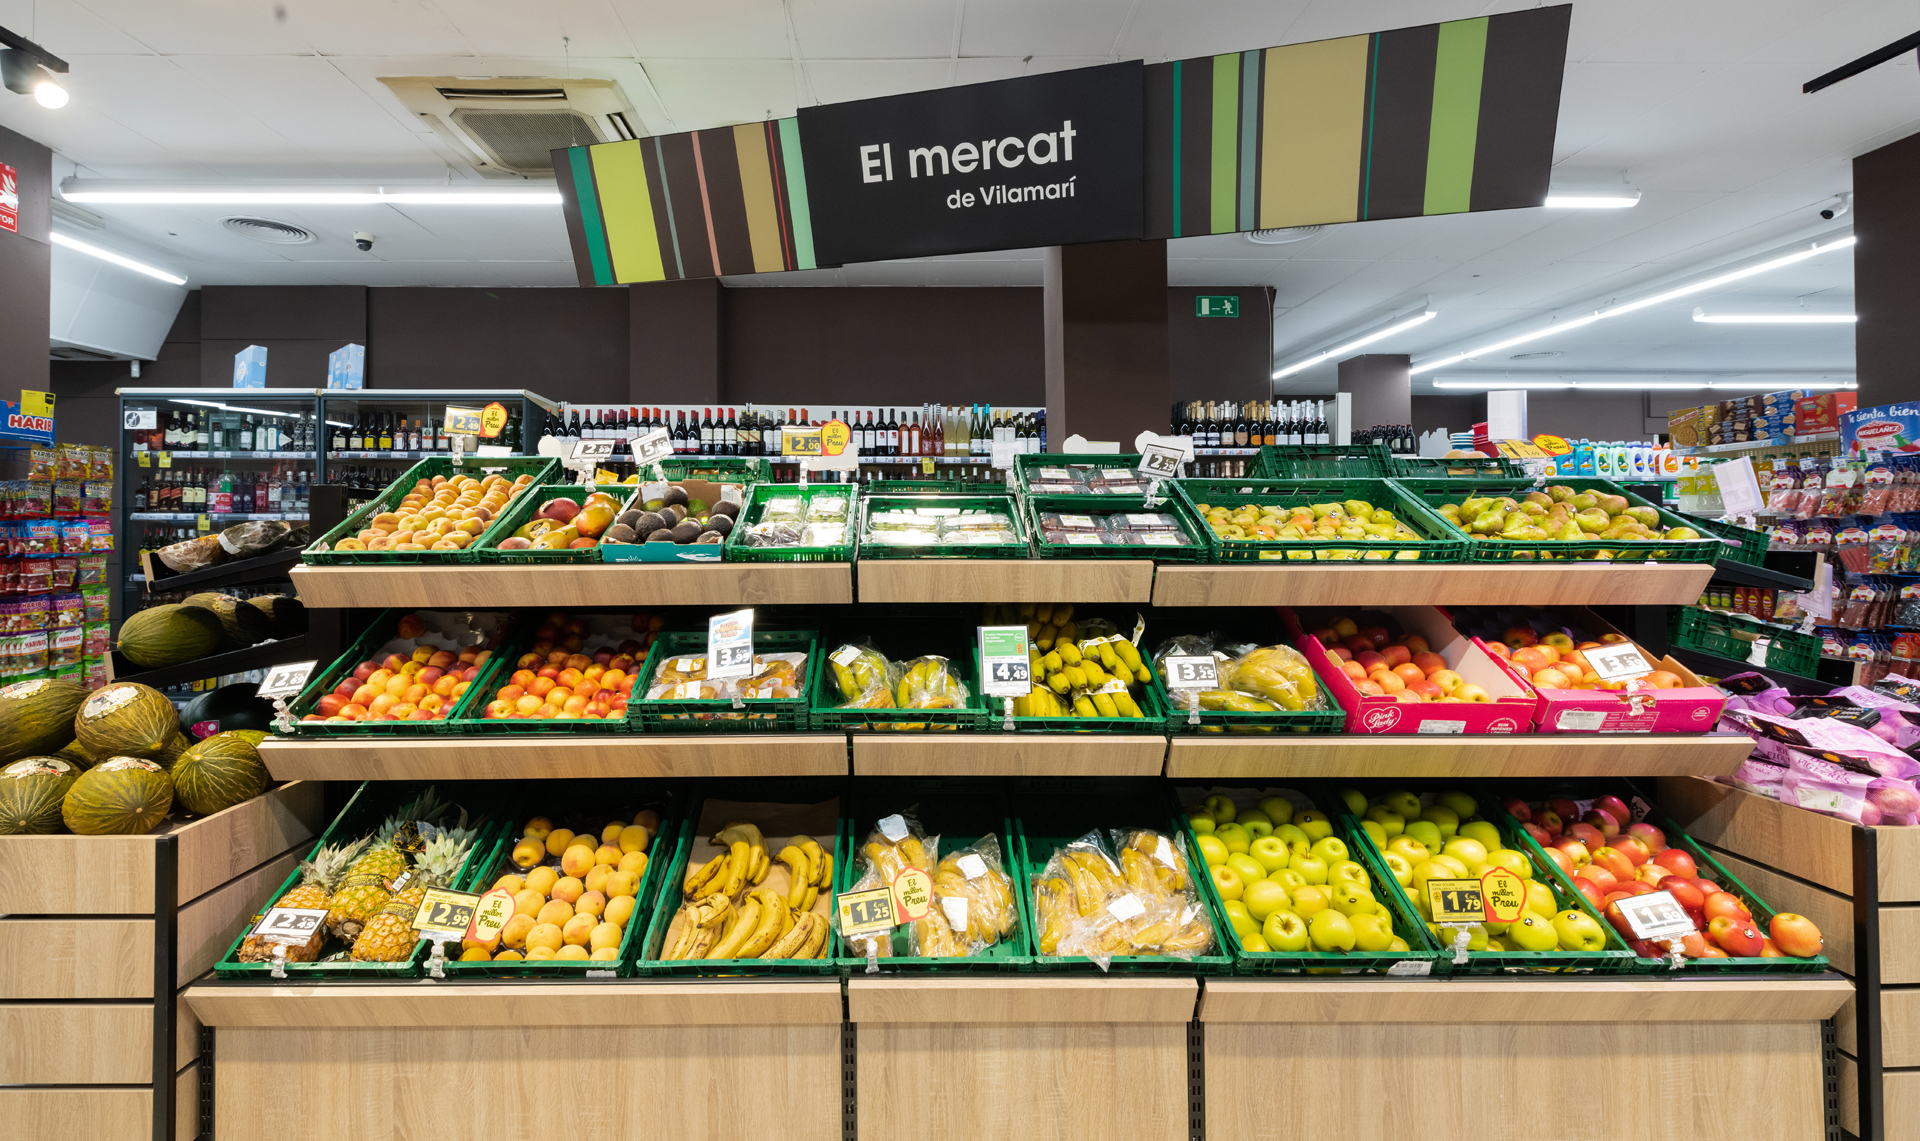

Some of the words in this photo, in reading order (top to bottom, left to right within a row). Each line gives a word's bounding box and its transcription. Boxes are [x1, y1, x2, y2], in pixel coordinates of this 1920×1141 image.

[860, 143, 893, 184] El
[908, 119, 1077, 179] mercat
[946, 189, 976, 209] de
[979, 175, 1077, 206] Vilamarí
[1856, 408, 1886, 422] sienta
[1889, 405, 1920, 417] bien
[456, 416, 479, 430] 2,49
[1858, 425, 1900, 437] MIGUELAÑEZ
[585, 444, 611, 454] 2,99
[795, 437, 820, 451] 2,00
[1151, 455, 1174, 470] 2,29
[721, 649, 749, 665] 3,99
[997, 663, 1028, 681] 4,49
[1182, 664, 1214, 680] 3,25
[275, 673, 304, 687] 2,69
[1369, 709, 1394, 723] Pink
[1370, 718, 1394, 728] Lady
[907, 878, 917, 887] El
[1497, 880, 1507, 888] El
[903, 887, 923, 896] millor
[1492, 888, 1515, 897] millor
[903, 895, 928, 906] Preu
[1447, 891, 1482, 912] 1,79
[1491, 896, 1519, 907] Preu
[434, 904, 470, 926] 2,99
[483, 908, 503, 917] millor
[856, 902, 889, 921] 1,25
[277, 915, 316, 929] 2,49
[478, 915, 501, 929] Preu
